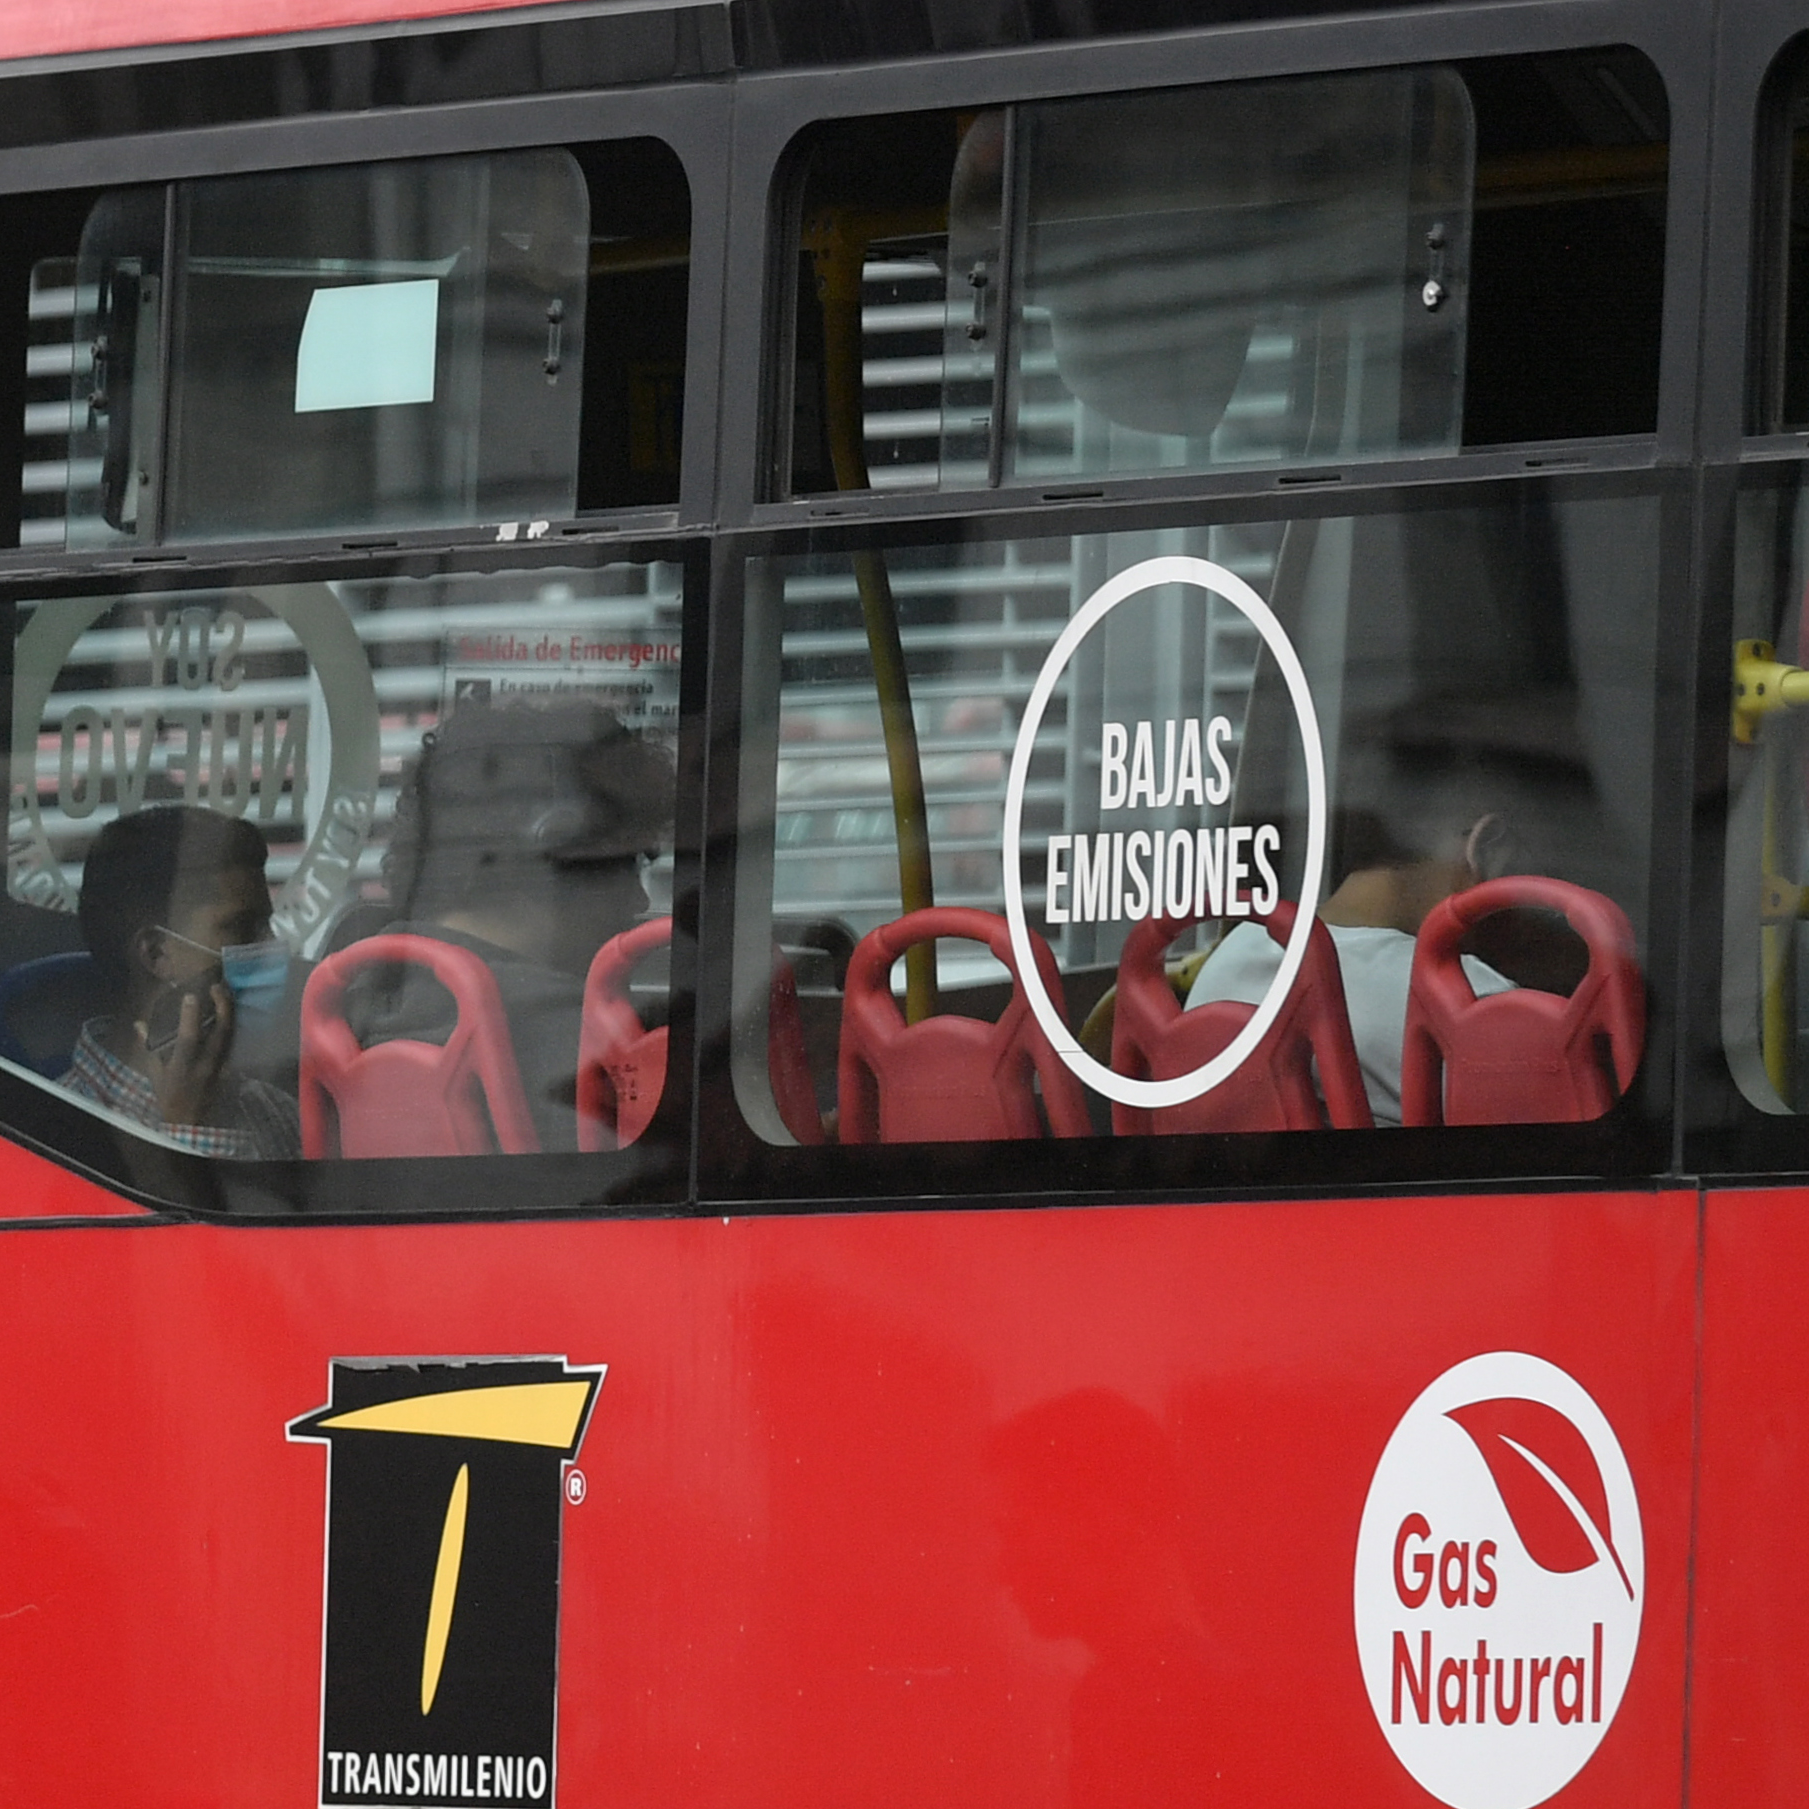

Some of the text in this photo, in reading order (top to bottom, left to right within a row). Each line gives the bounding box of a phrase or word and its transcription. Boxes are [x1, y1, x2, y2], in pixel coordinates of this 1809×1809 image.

[459, 634, 528, 662] Salida
[535, 635, 562, 662] de
[1100, 716, 1232, 810] BAJAS
[1046, 824, 1280, 924] EMISIONES
[1393, 1512, 1497, 1609] Gas
[1390, 1622, 1603, 1726] Natural
[327, 1751, 547, 1799] TRANSMILENIO
